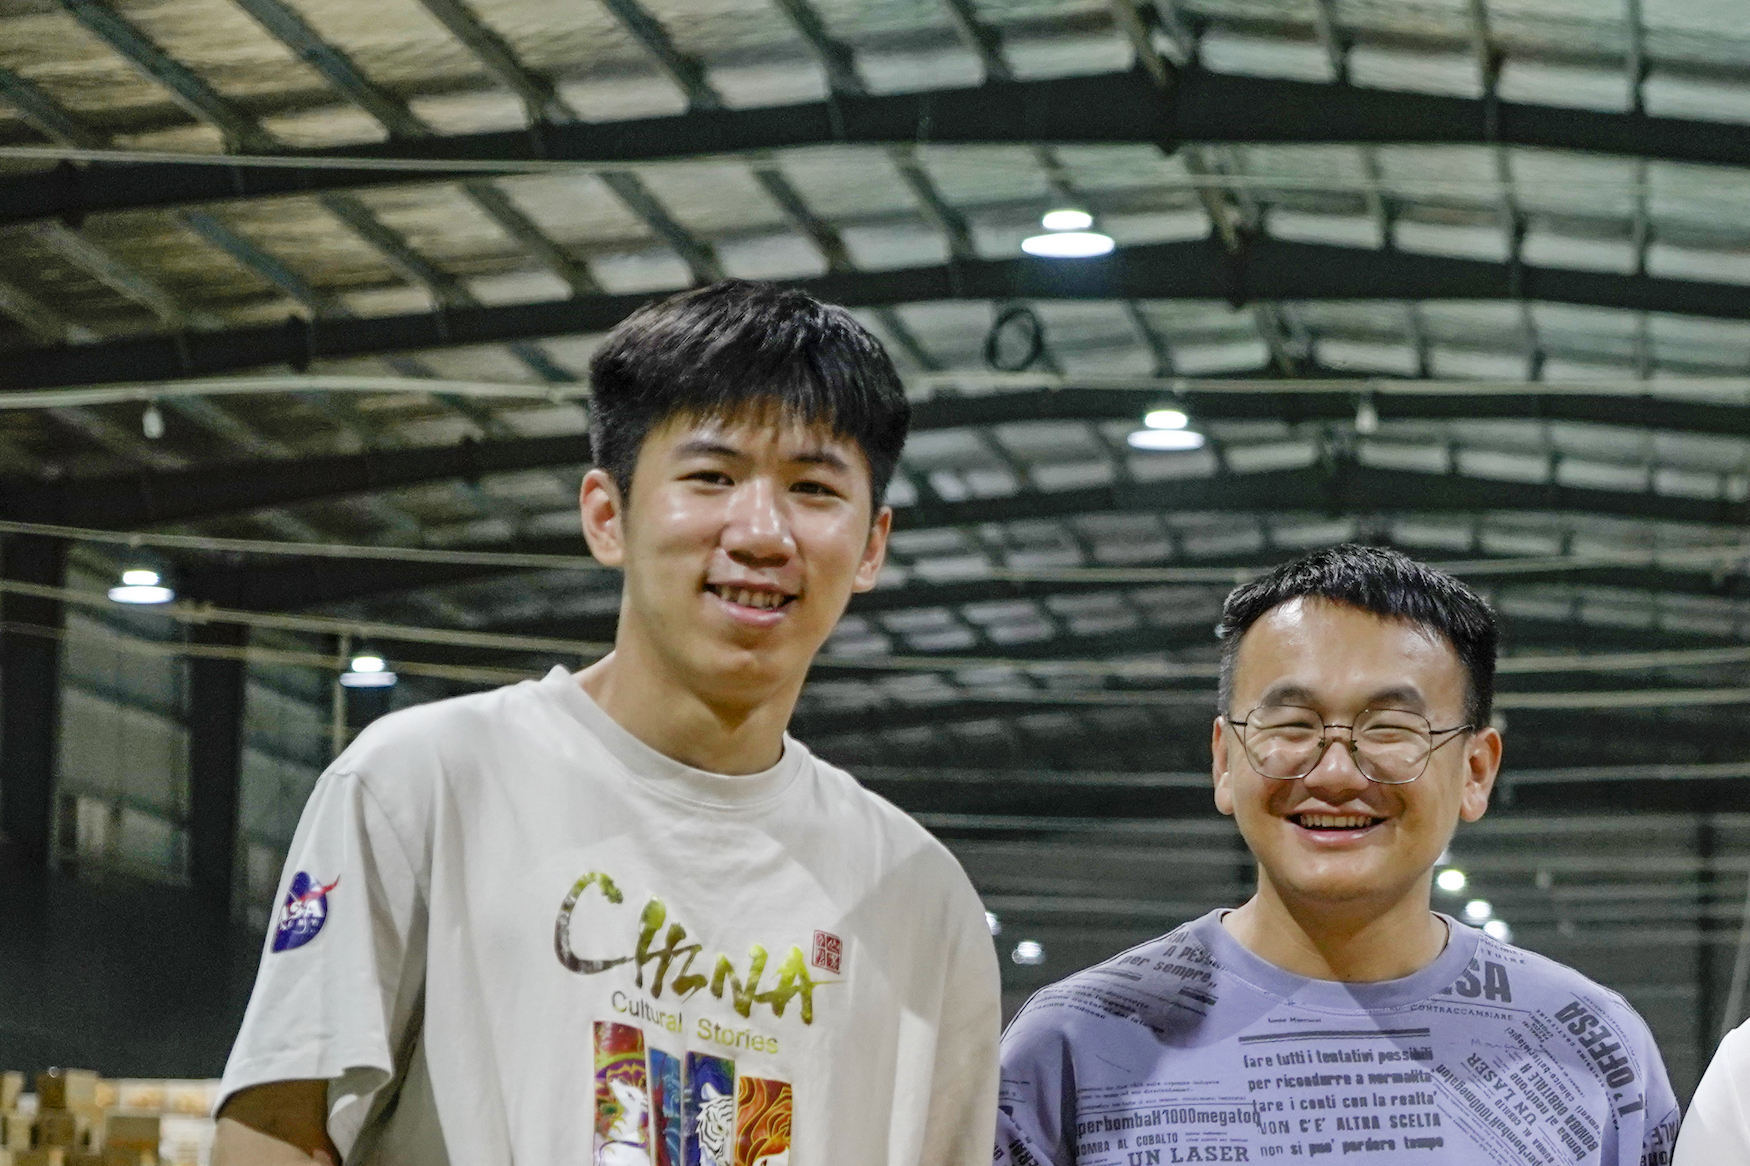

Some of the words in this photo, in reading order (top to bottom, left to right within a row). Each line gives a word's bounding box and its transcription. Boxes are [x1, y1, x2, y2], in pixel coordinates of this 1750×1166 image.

[611, 990, 682, 1033] Cultural
[697, 1017, 779, 1054] Stories
[1248, 1078, 1271, 1092] per
[1465, 1051, 1516, 1102] LASER
[1507, 1071, 1549, 1116] neutrone
[1526, 1070, 1570, 1117] ORBITALE
[1336, 1115, 1380, 1131] ALTRA
[1389, 1113, 1441, 1129] SCELTA
[1511, 1099, 1538, 1126] UN
[1543, 1113, 1559, 1129] al
[1136, 1132, 1178, 1147] COBALTO
[1553, 1125, 1587, 1162] bomba
[1562, 1112, 1599, 1153] BOMBA
[1170, 1146, 1249, 1163] LASER
[1260, 1144, 1283, 1157] non
